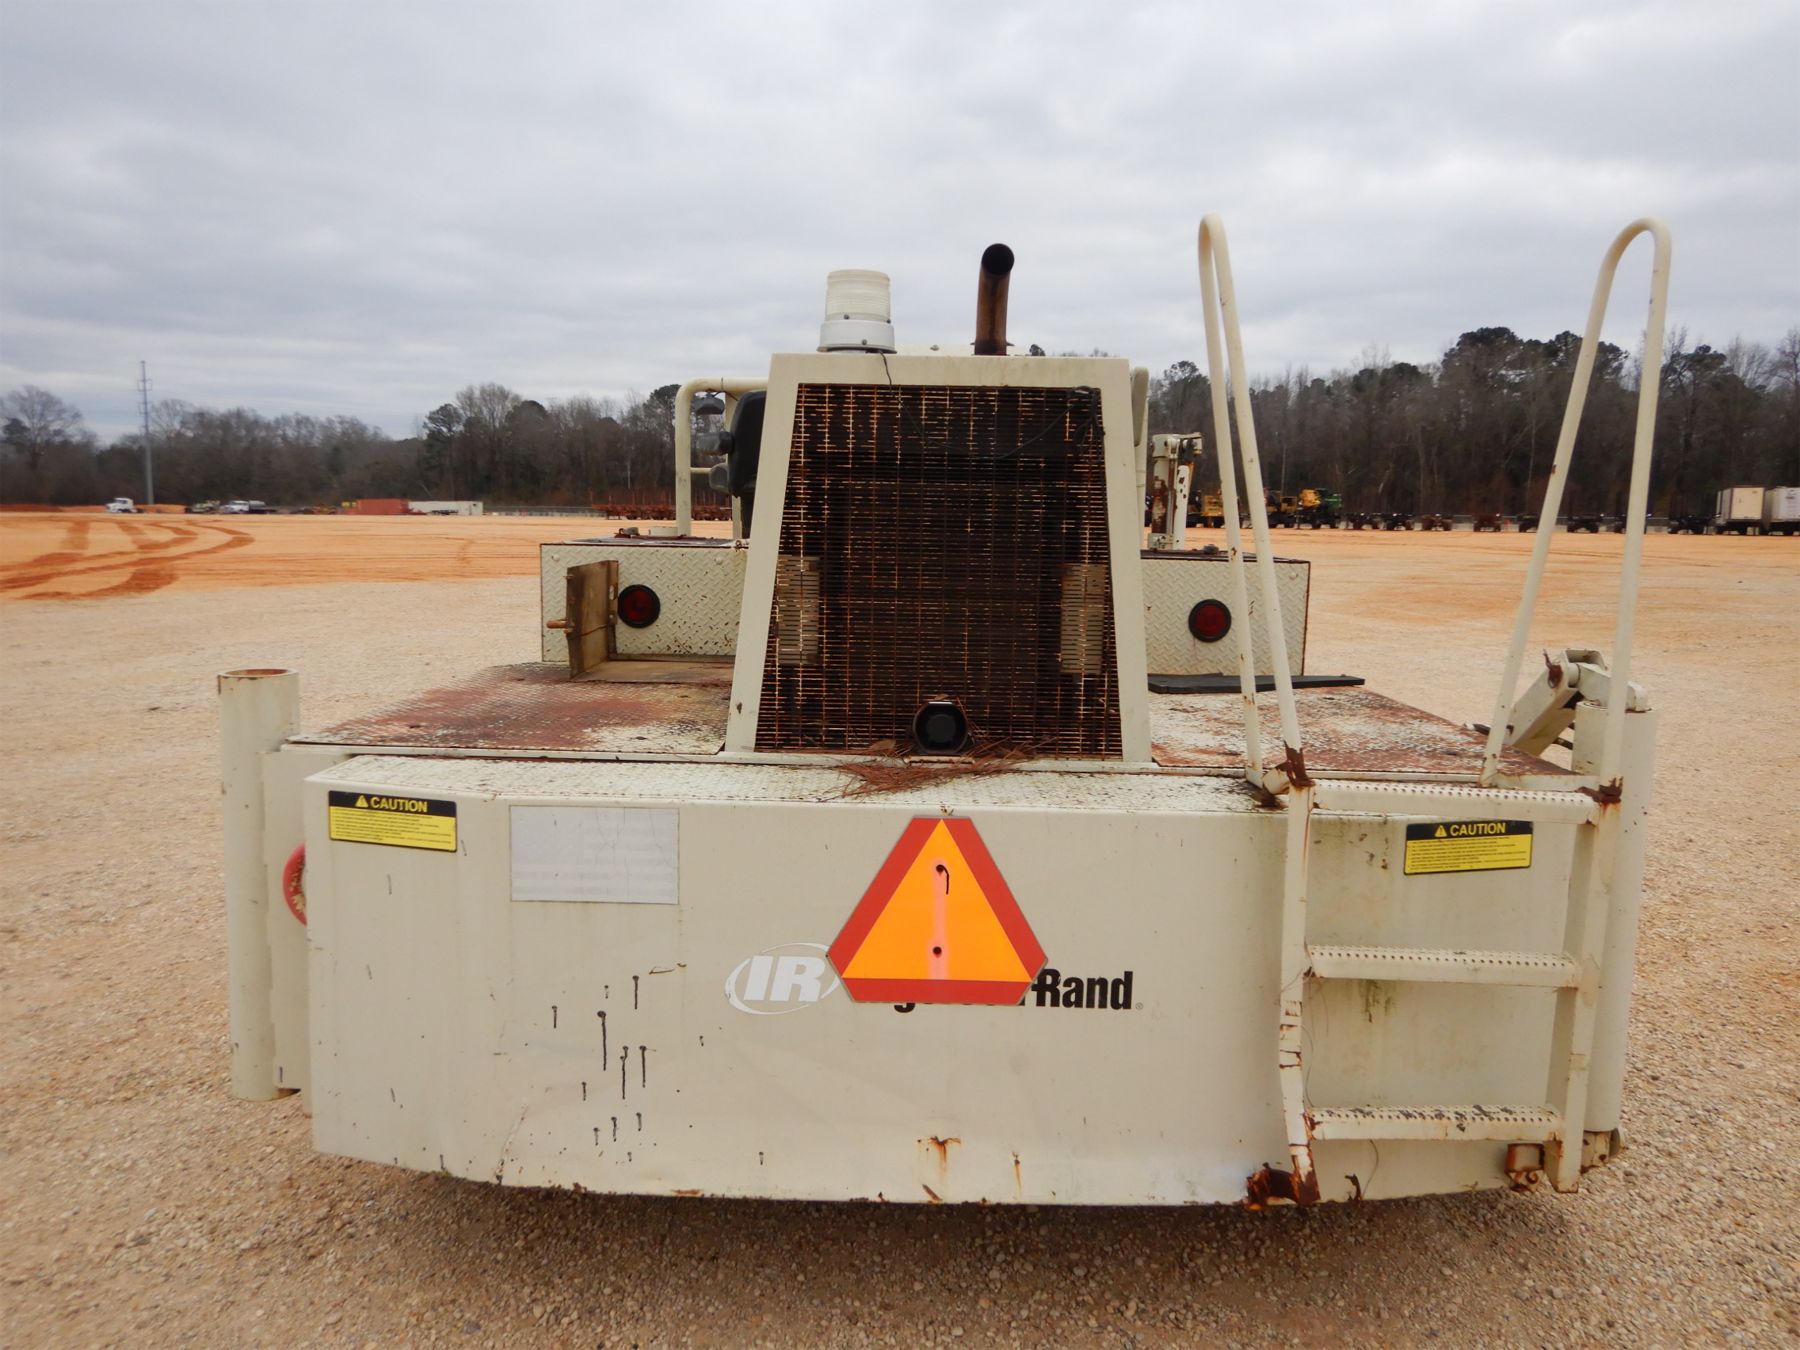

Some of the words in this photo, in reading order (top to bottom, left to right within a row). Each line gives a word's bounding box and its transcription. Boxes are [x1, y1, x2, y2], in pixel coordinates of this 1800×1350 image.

[370, 796, 428, 813] CAUTION
[1450, 822, 1506, 836] CAUTION
[743, 955, 826, 1002] IR
